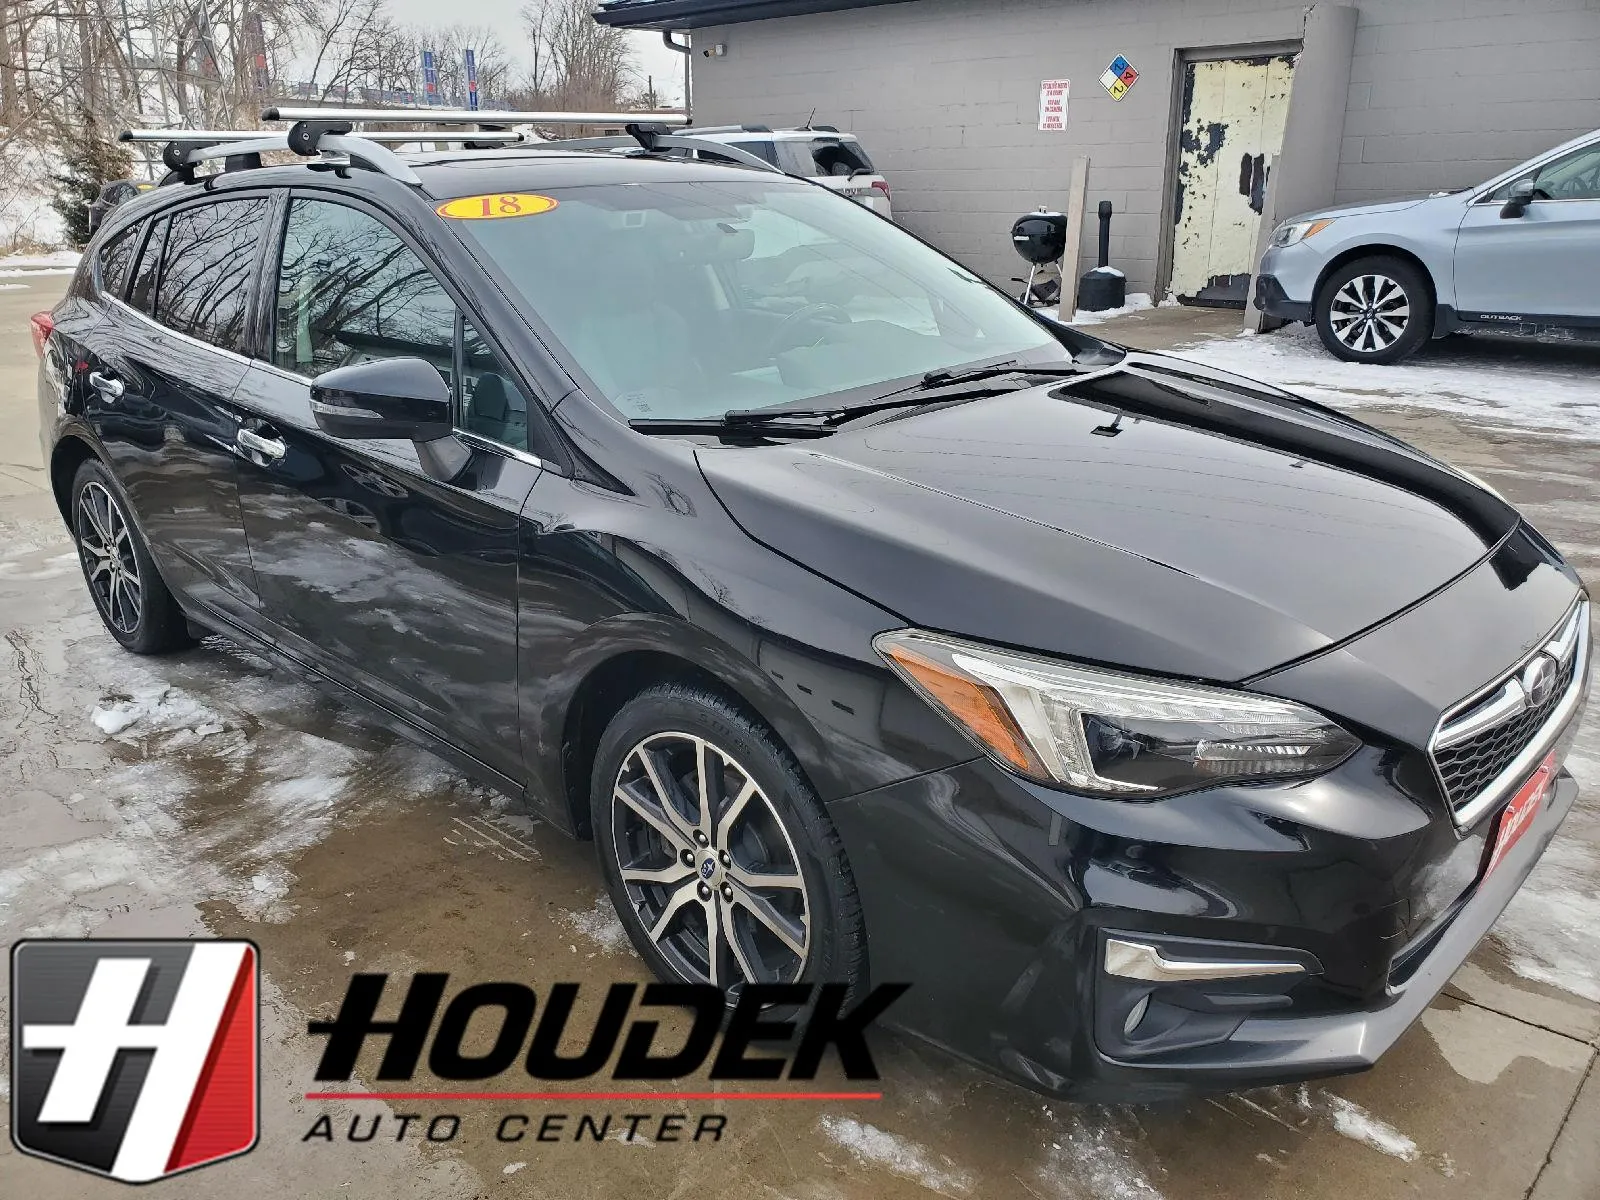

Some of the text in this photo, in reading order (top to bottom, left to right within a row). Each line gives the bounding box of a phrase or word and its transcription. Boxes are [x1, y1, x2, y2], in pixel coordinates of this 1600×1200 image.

[1114, 62, 1125, 71] 2
[1124, 71, 1134, 80] 4
[1113, 85, 1124, 94] 2
[480, 195, 522, 217] 18
